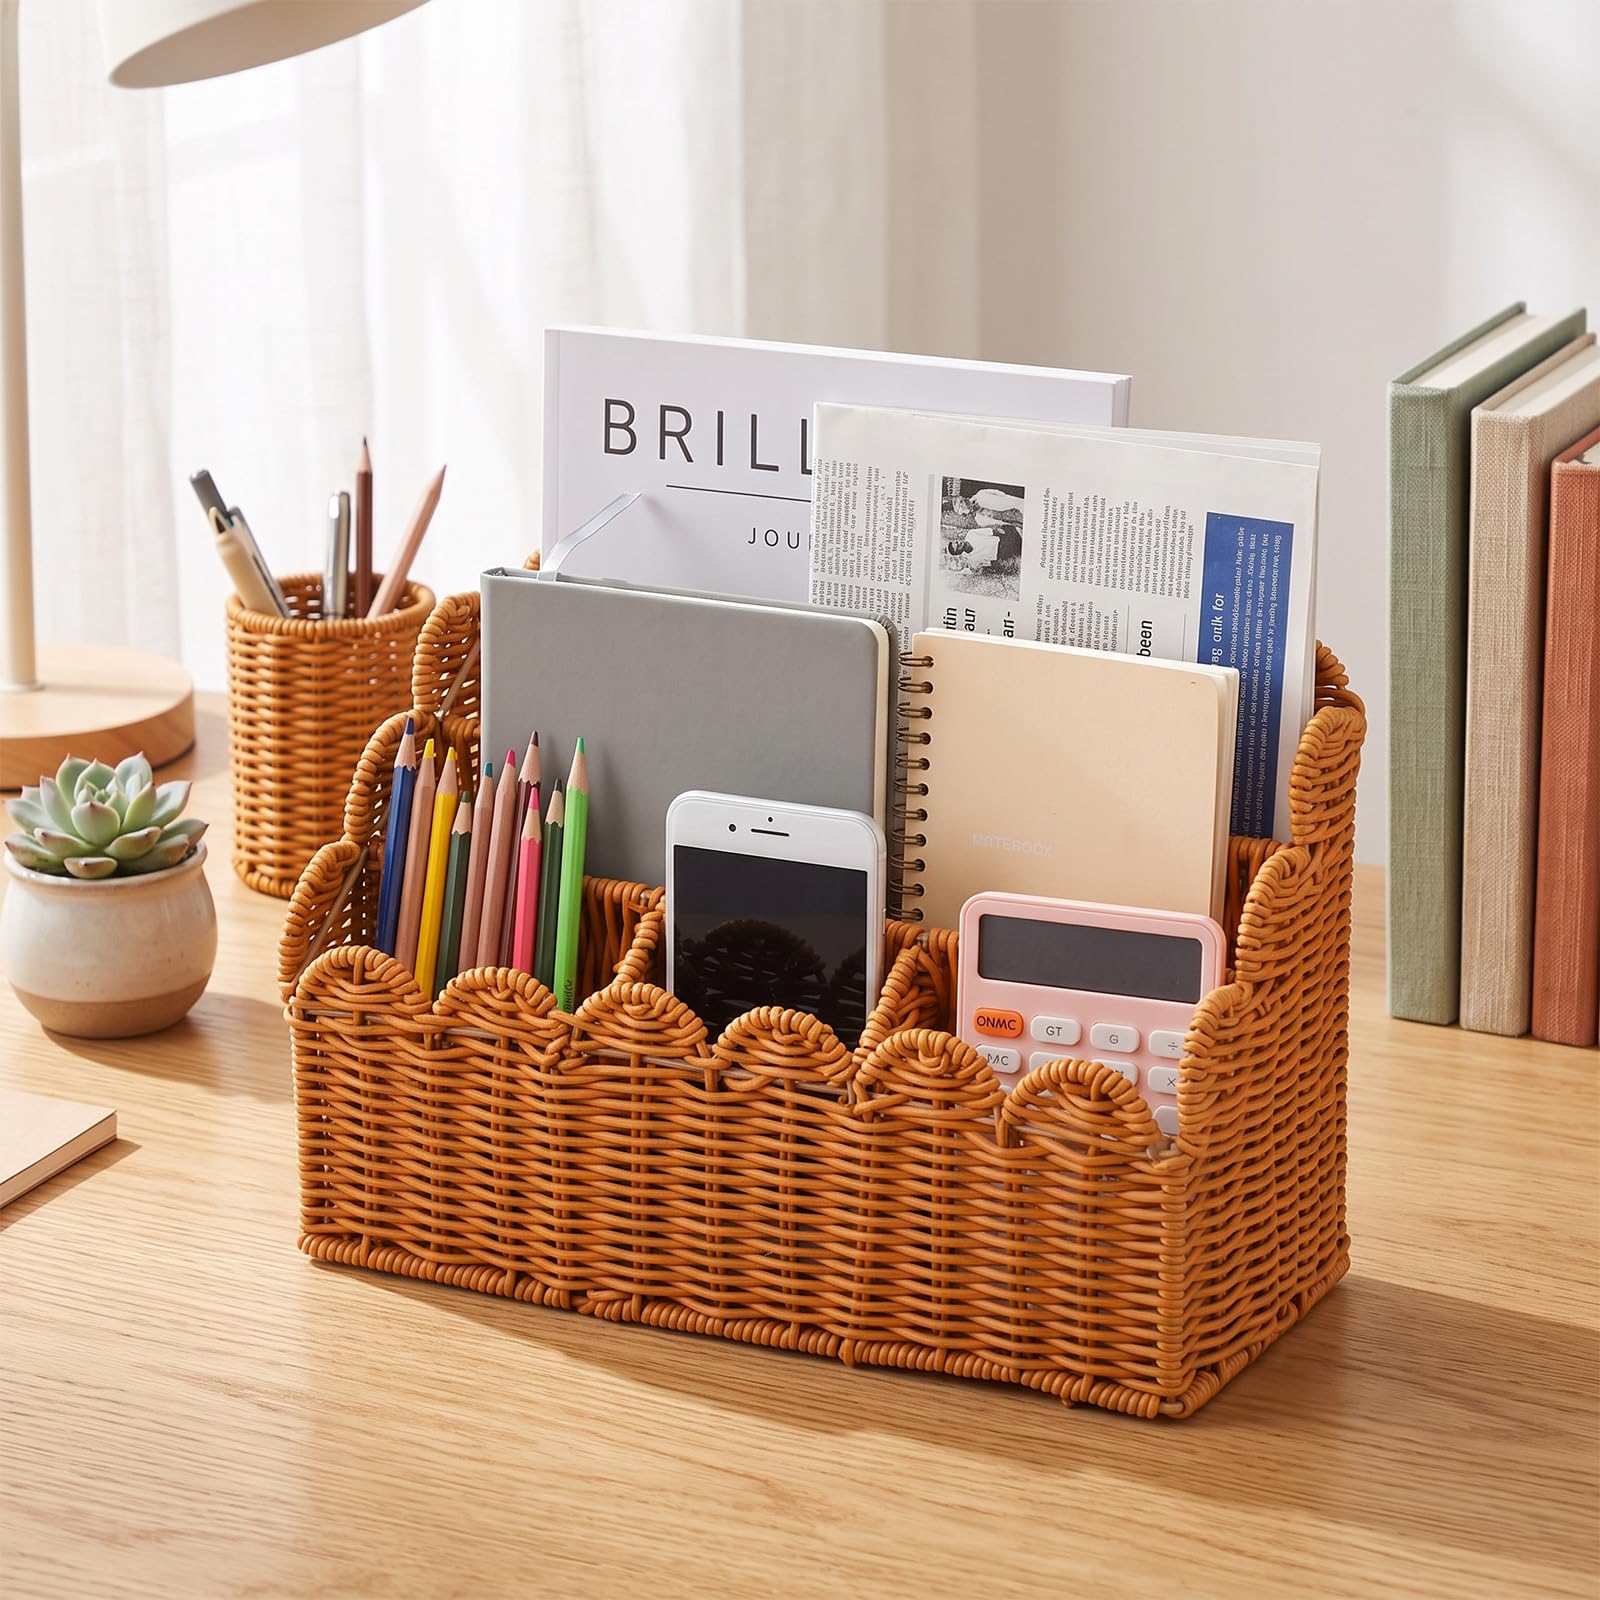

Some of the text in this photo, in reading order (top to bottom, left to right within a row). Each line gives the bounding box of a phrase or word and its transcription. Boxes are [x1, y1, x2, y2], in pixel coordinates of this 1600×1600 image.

[747, 527, 811, 551] JOU
[1045, 1025, 1063, 1037] GT
[987, 1053, 1009, 1066] MC
